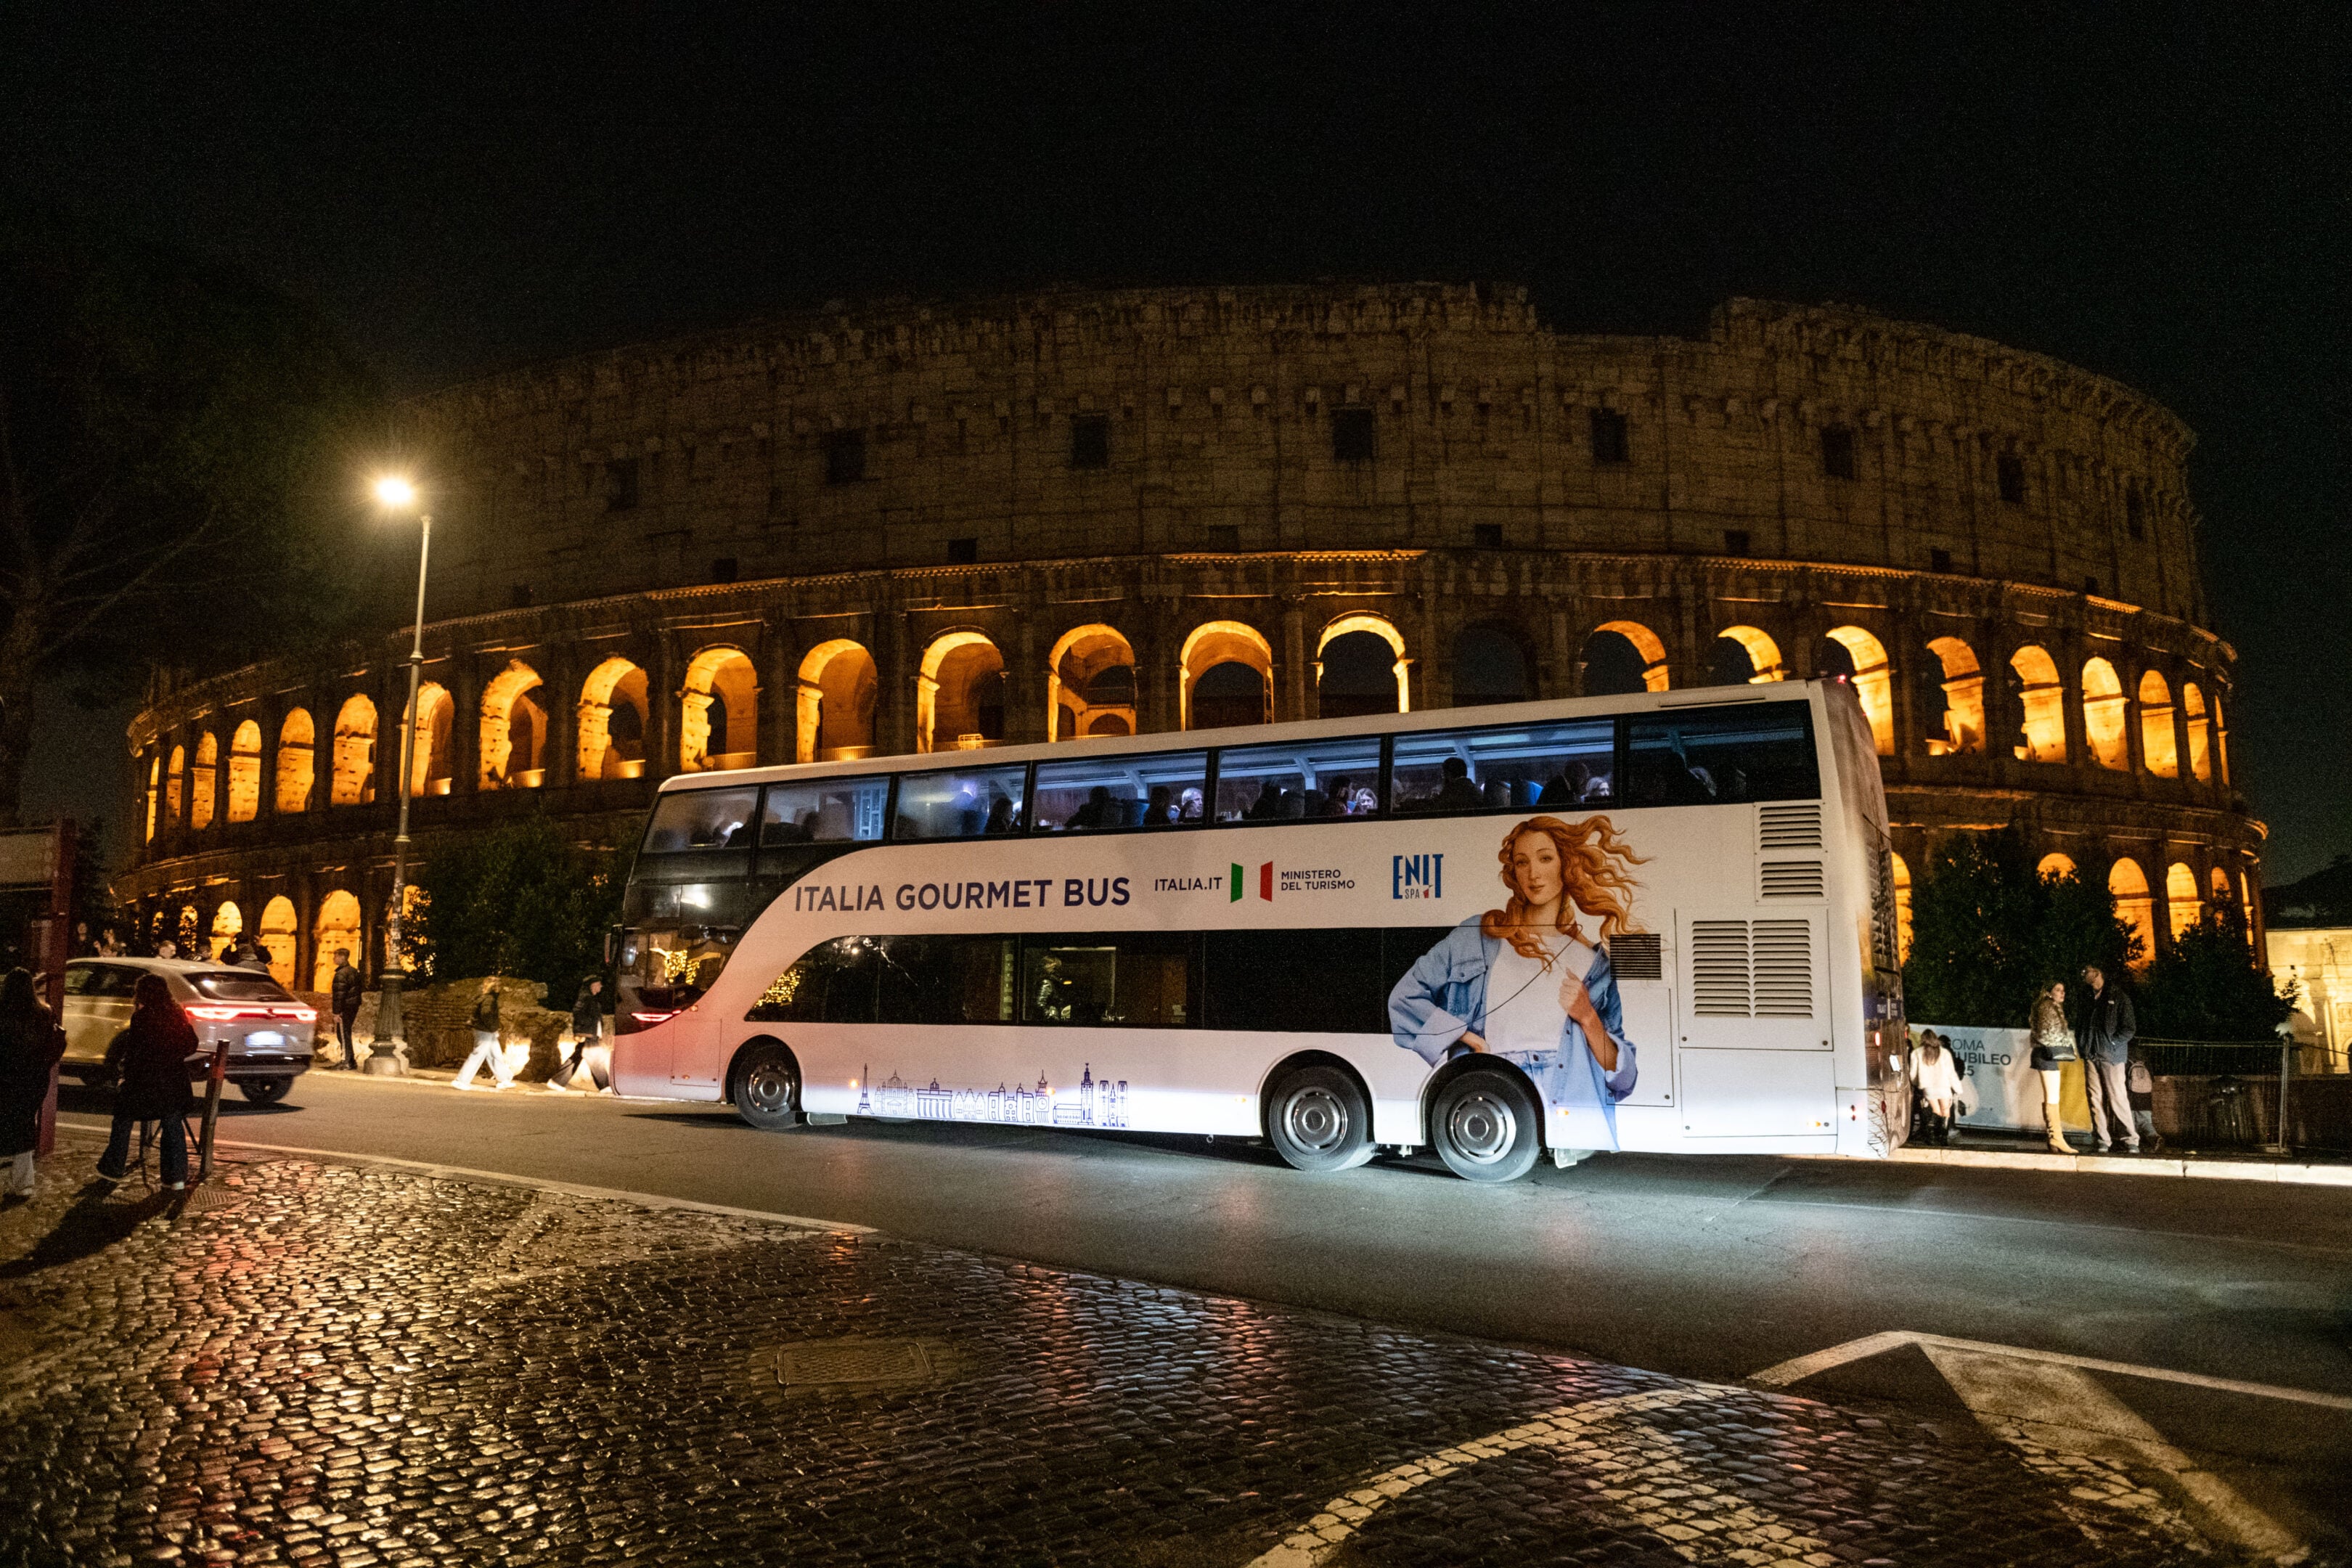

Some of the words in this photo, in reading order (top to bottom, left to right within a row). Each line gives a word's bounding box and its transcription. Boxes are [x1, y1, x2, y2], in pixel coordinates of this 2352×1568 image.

[1281, 869, 1342, 881] MINISTERO
[1392, 853, 1444, 899] ENIT
[1154, 876, 1222, 891] ITALIA.IT
[1281, 881, 1302, 891] DEL
[1304, 879, 1355, 890] TURISMO
[795, 884, 885, 912] ITALIA
[895, 879, 1053, 910] GOURMET
[1063, 876, 1130, 907] BUS
[1405, 888, 1420, 899] SPA
[1951, 1038, 1985, 1051] OMA
[1954, 1050, 2012, 1066] UBILEO
